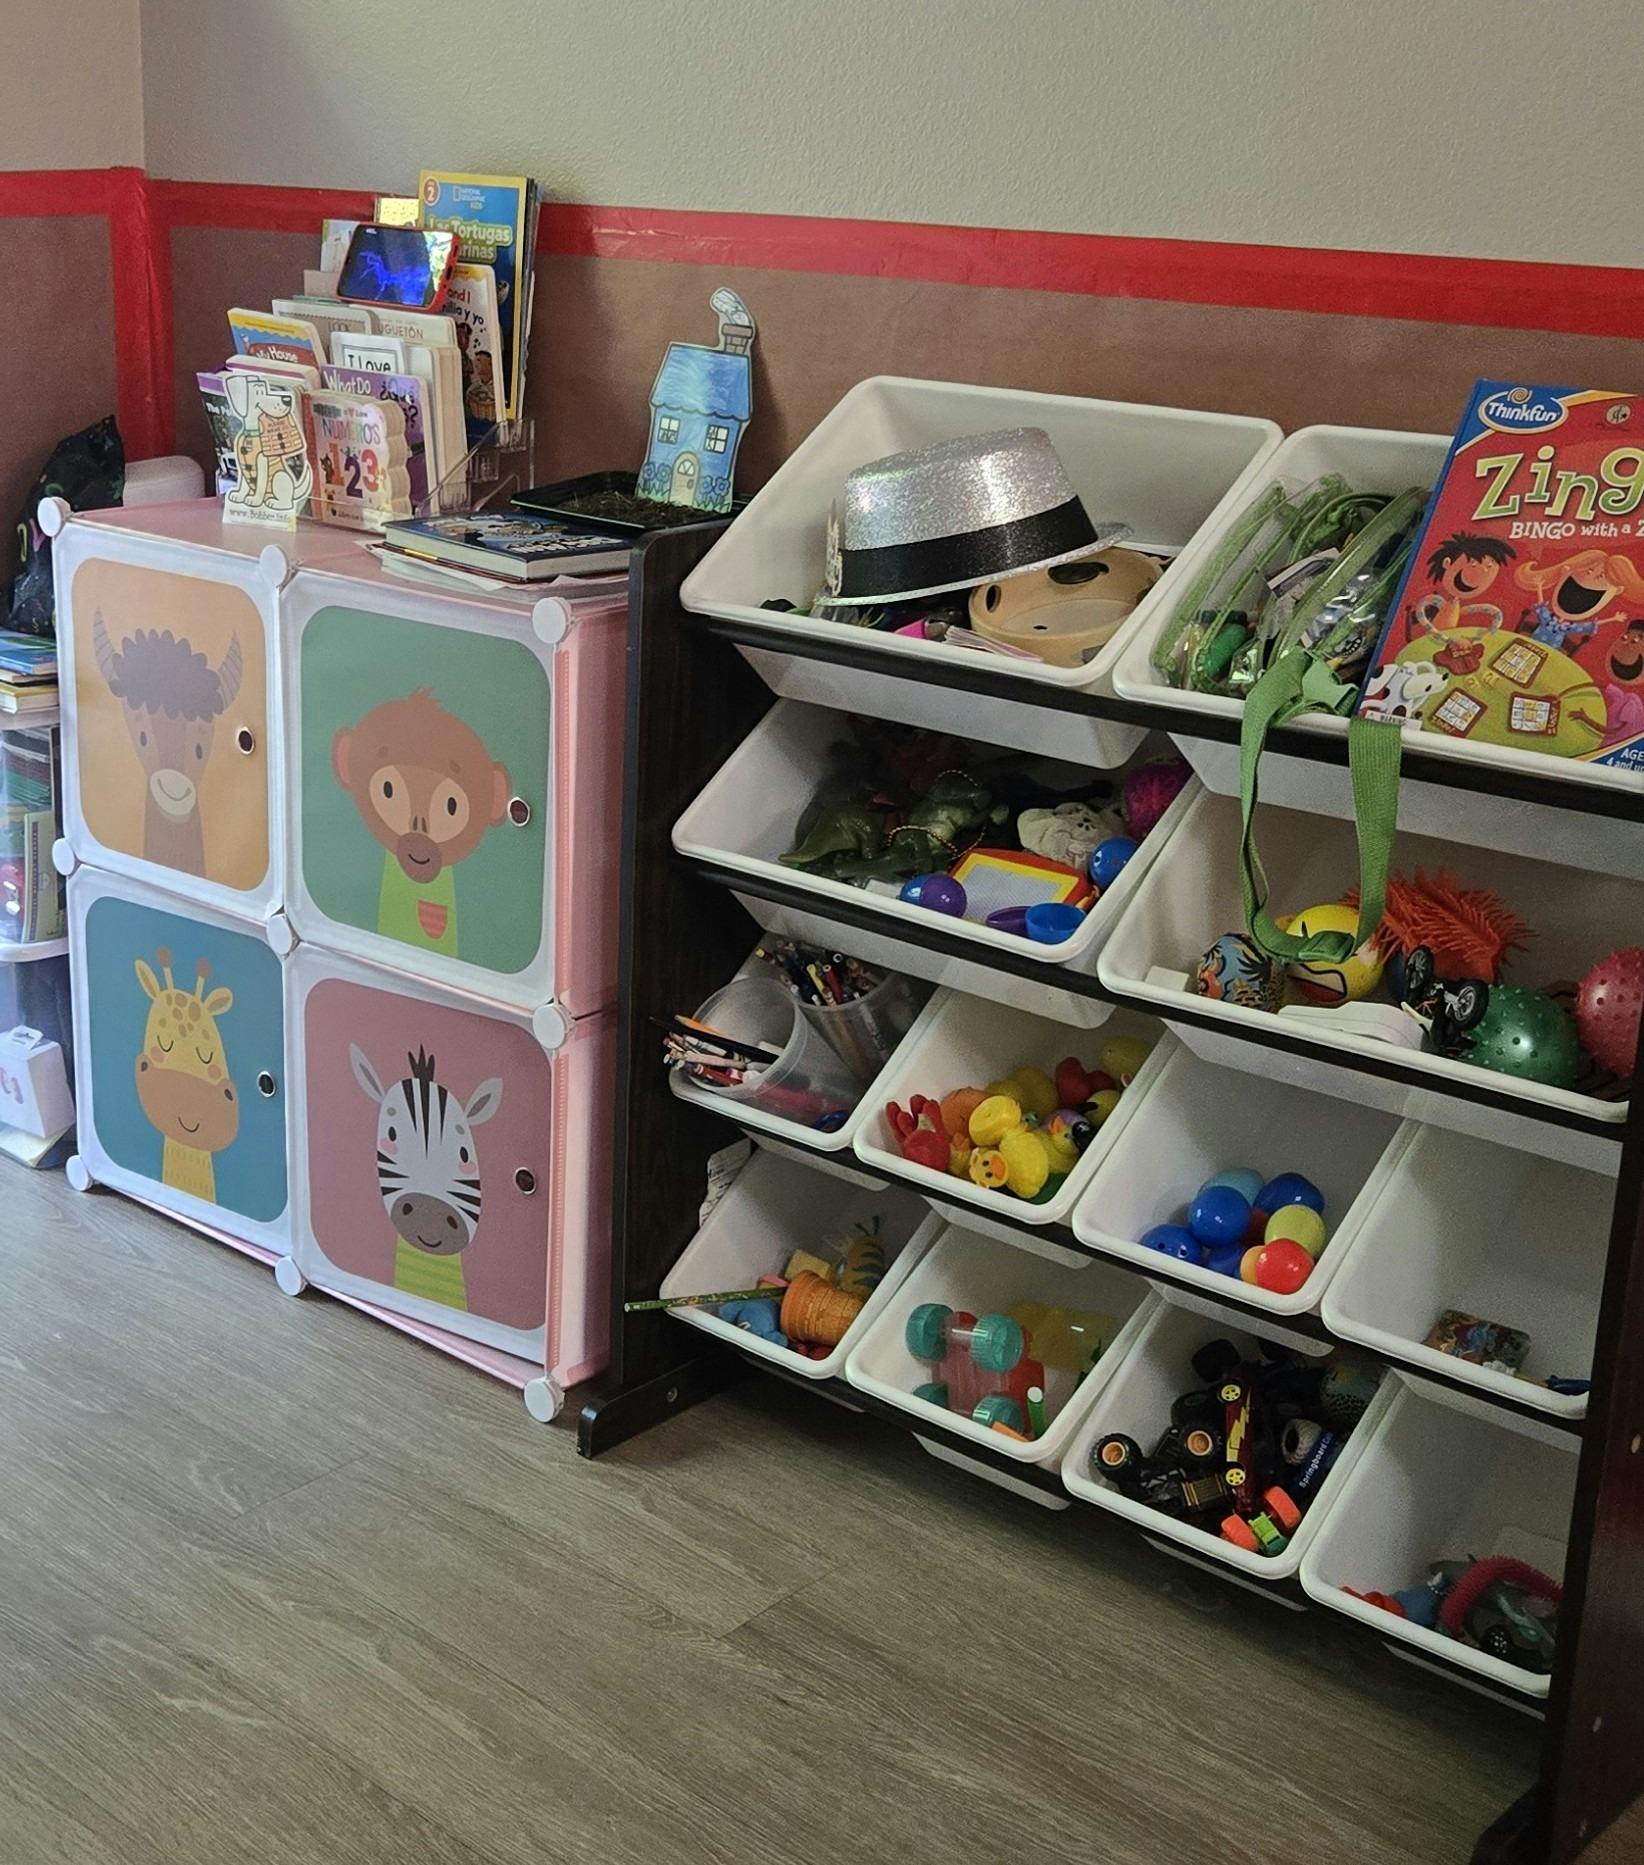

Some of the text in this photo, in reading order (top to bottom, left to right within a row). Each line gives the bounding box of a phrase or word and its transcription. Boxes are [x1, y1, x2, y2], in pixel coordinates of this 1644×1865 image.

[426, 189, 436, 202] 2
[451, 219, 511, 245] Tortugas
[462, 240, 496, 260] rinas
[1509, 521, 1576, 540] BINGO
[1581, 520, 1619, 538] with
[1621, 523, 1632, 534] a
[1606, 756, 1615, 767] 4
[1614, 760, 1634, 770] and
[1298, 1442, 1328, 1489] Springboard
